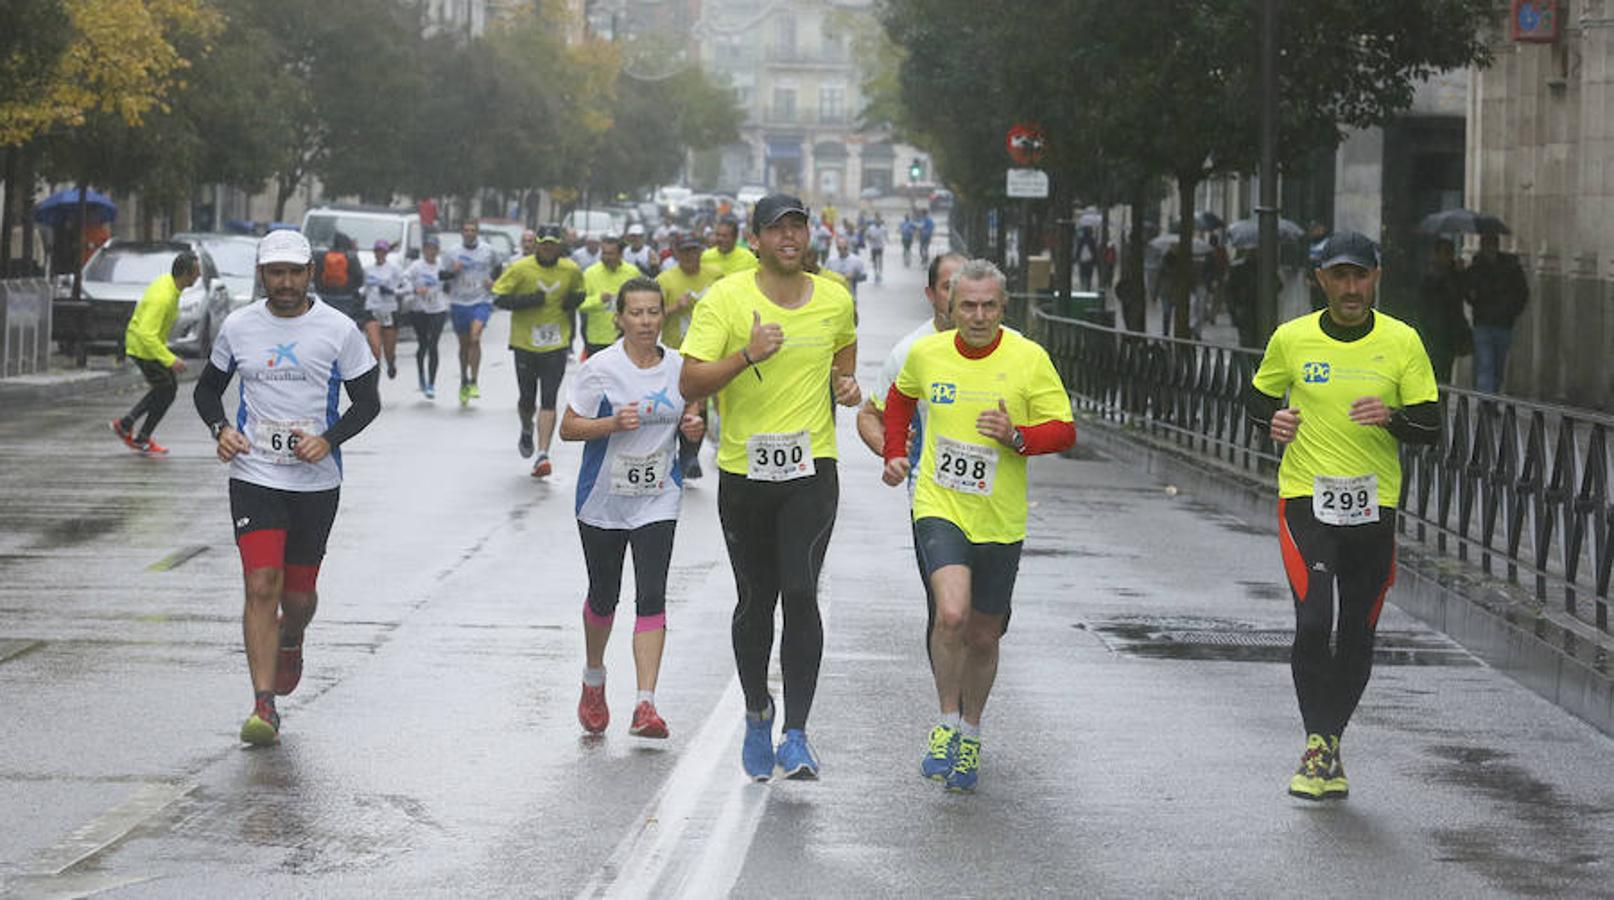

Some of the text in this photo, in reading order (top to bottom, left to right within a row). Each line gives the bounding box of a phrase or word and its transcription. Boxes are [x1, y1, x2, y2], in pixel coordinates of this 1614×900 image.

[1304, 362, 1329, 383] PPG
[931, 383, 956, 403] PPG
[271, 433, 298, 451] 66
[755, 446, 803, 467] 300
[940, 453, 986, 479] 298
[628, 466, 655, 484] 65
[1322, 490, 1368, 510] 299
